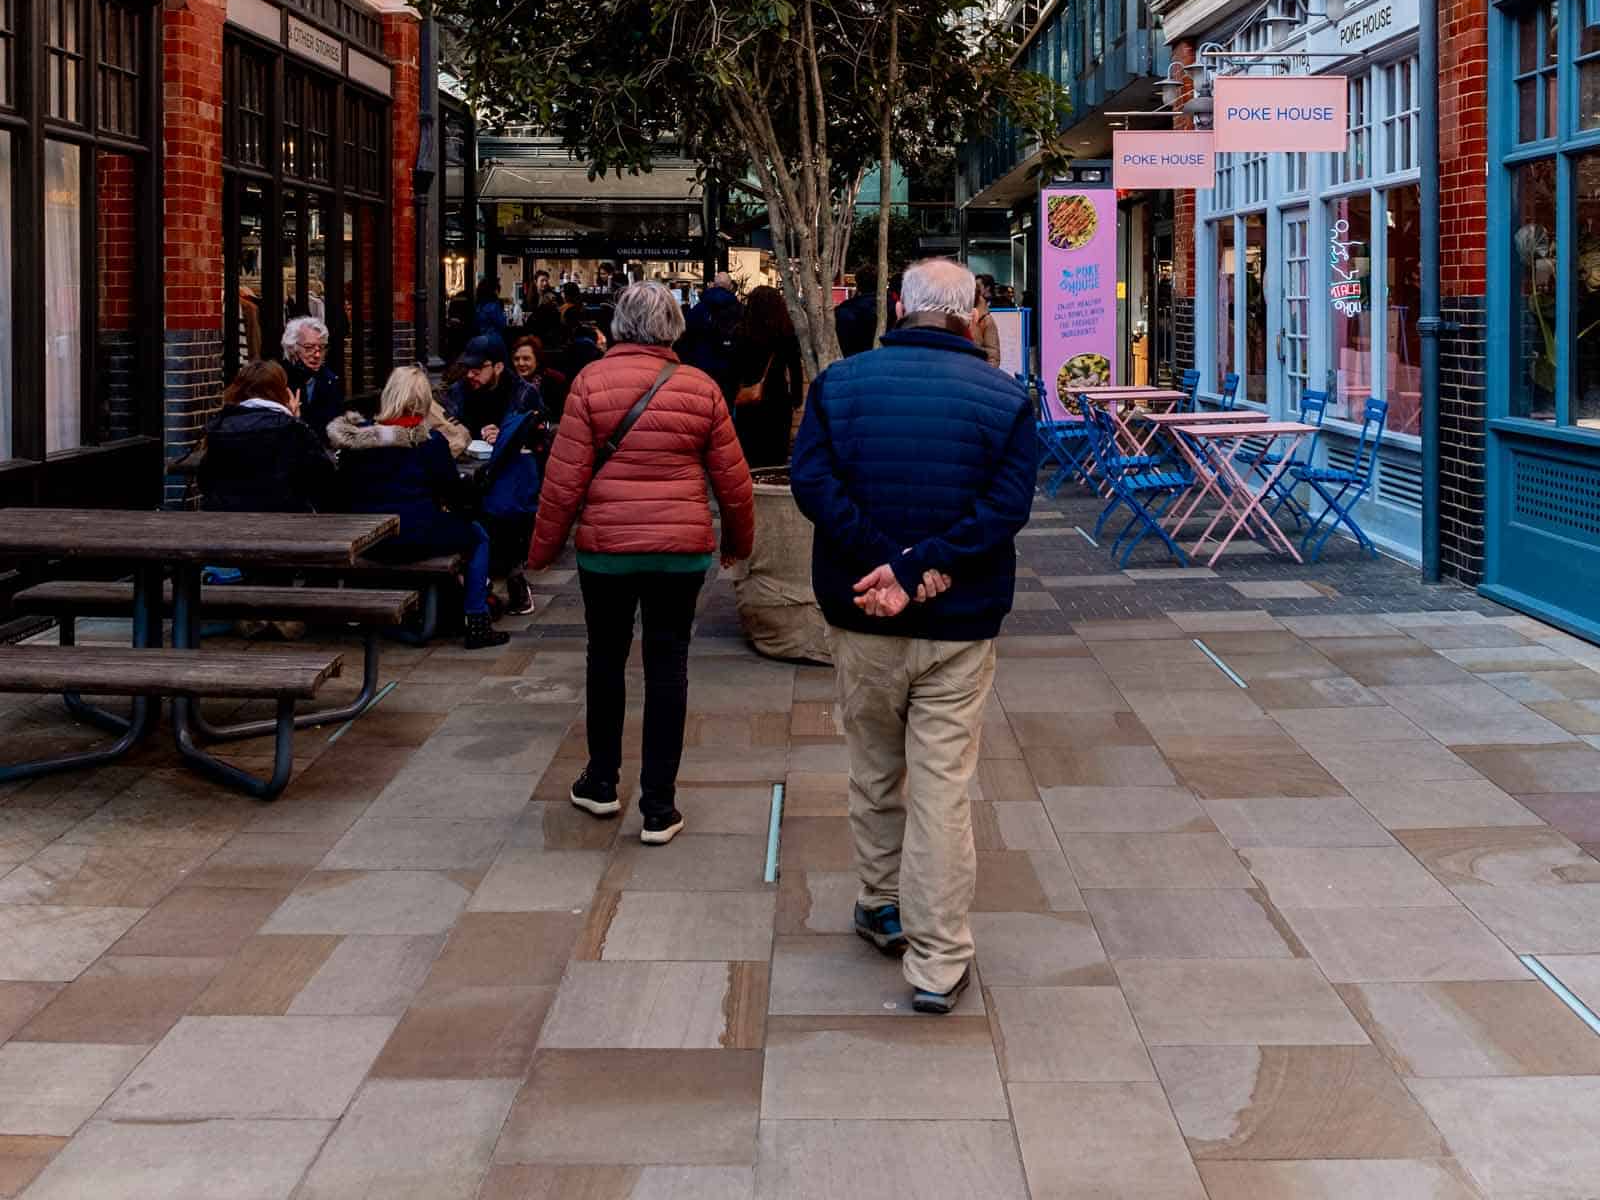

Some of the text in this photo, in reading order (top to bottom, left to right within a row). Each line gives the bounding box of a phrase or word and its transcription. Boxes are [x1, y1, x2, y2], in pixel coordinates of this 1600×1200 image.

[1340, 6, 1392, 48] POKE HOUSE
[294, 26, 314, 49] OTHER
[315, 37, 339, 63] STORIES
[1227, 107, 1334, 121] POKE HOUSE
[1123, 154, 1206, 165] POKE HOUSE
[616, 247, 679, 256] ORDER THIS WAY
[1075, 263, 1100, 278] POKE
[1069, 277, 1100, 291] HOUSE
